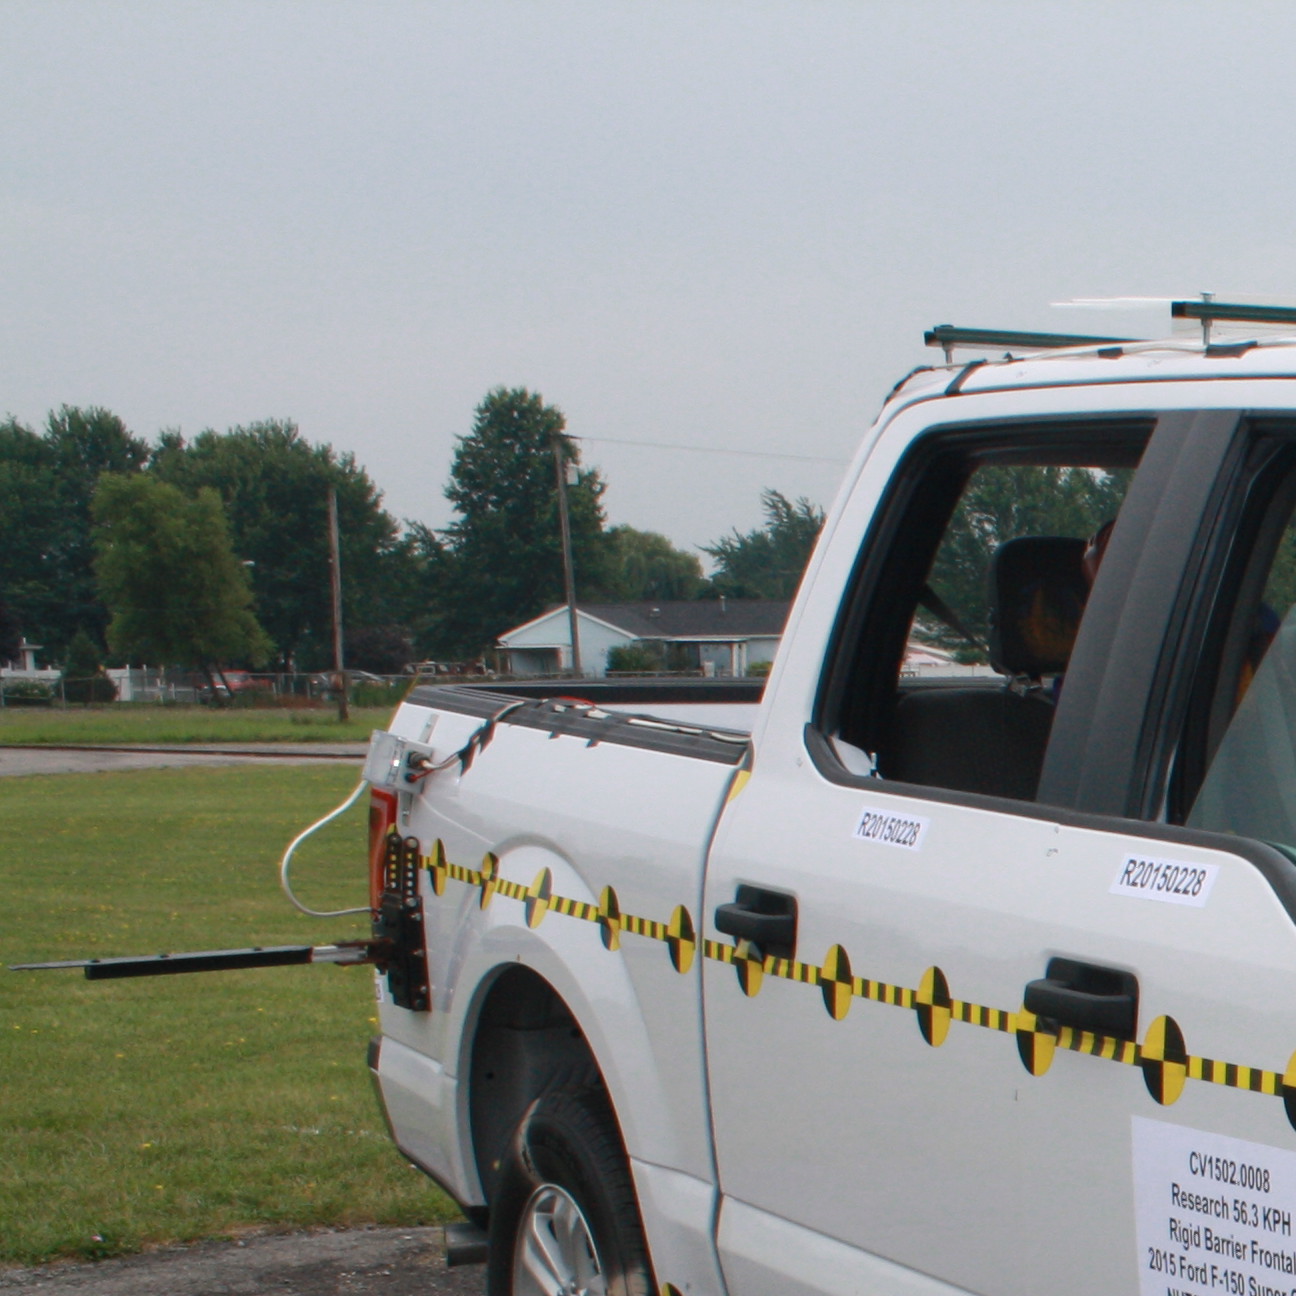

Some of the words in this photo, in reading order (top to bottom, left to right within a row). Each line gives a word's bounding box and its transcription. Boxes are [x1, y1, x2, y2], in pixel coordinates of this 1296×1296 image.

[858, 811, 921, 847] R20150228
[1120, 858, 1207, 897] R20150228
[1189, 1151, 1271, 1193] CV1502.0008
[1171, 1183, 1229, 1219] Research
[1233, 1199, 1259, 1228] 56.3
[1263, 1207, 1292, 1237] KPH
[1169, 1217, 1201, 1251] Rigid
[1205, 1227, 1247, 1260] Barrier
[1251, 1240, 1296, 1275] Frontal
[1148, 1247, 1177, 1276] 2015
[1180, 1257, 1207, 1284] Ford
[1211, 1265, 1245, 1296] F-150
